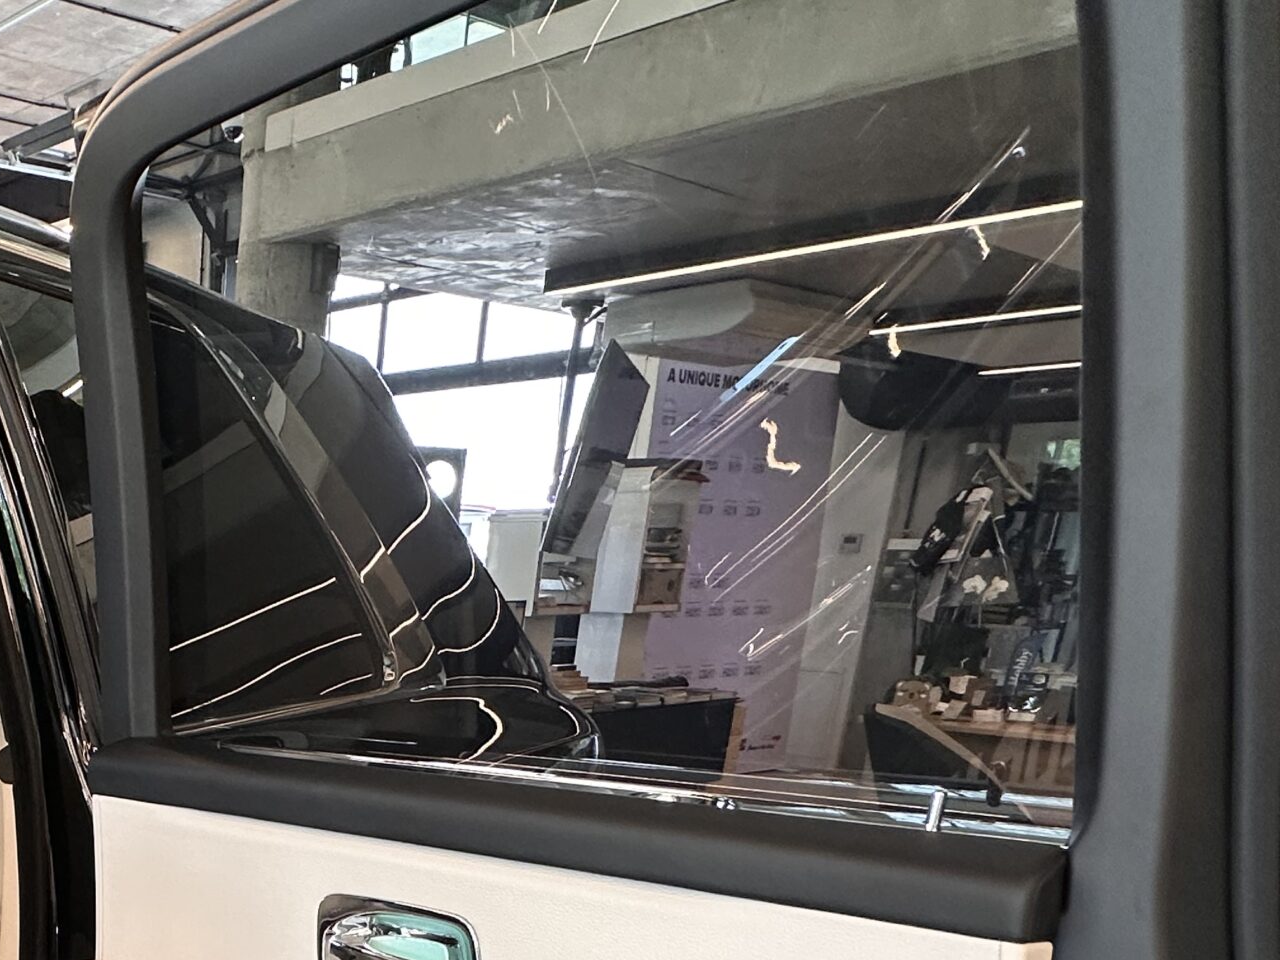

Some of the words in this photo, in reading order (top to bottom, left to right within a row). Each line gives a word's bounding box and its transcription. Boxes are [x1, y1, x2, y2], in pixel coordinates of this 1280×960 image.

[666, 367, 676, 382] A
[678, 369, 721, 388] UNIQUE
[722, 373, 790, 396] MOORHOME
